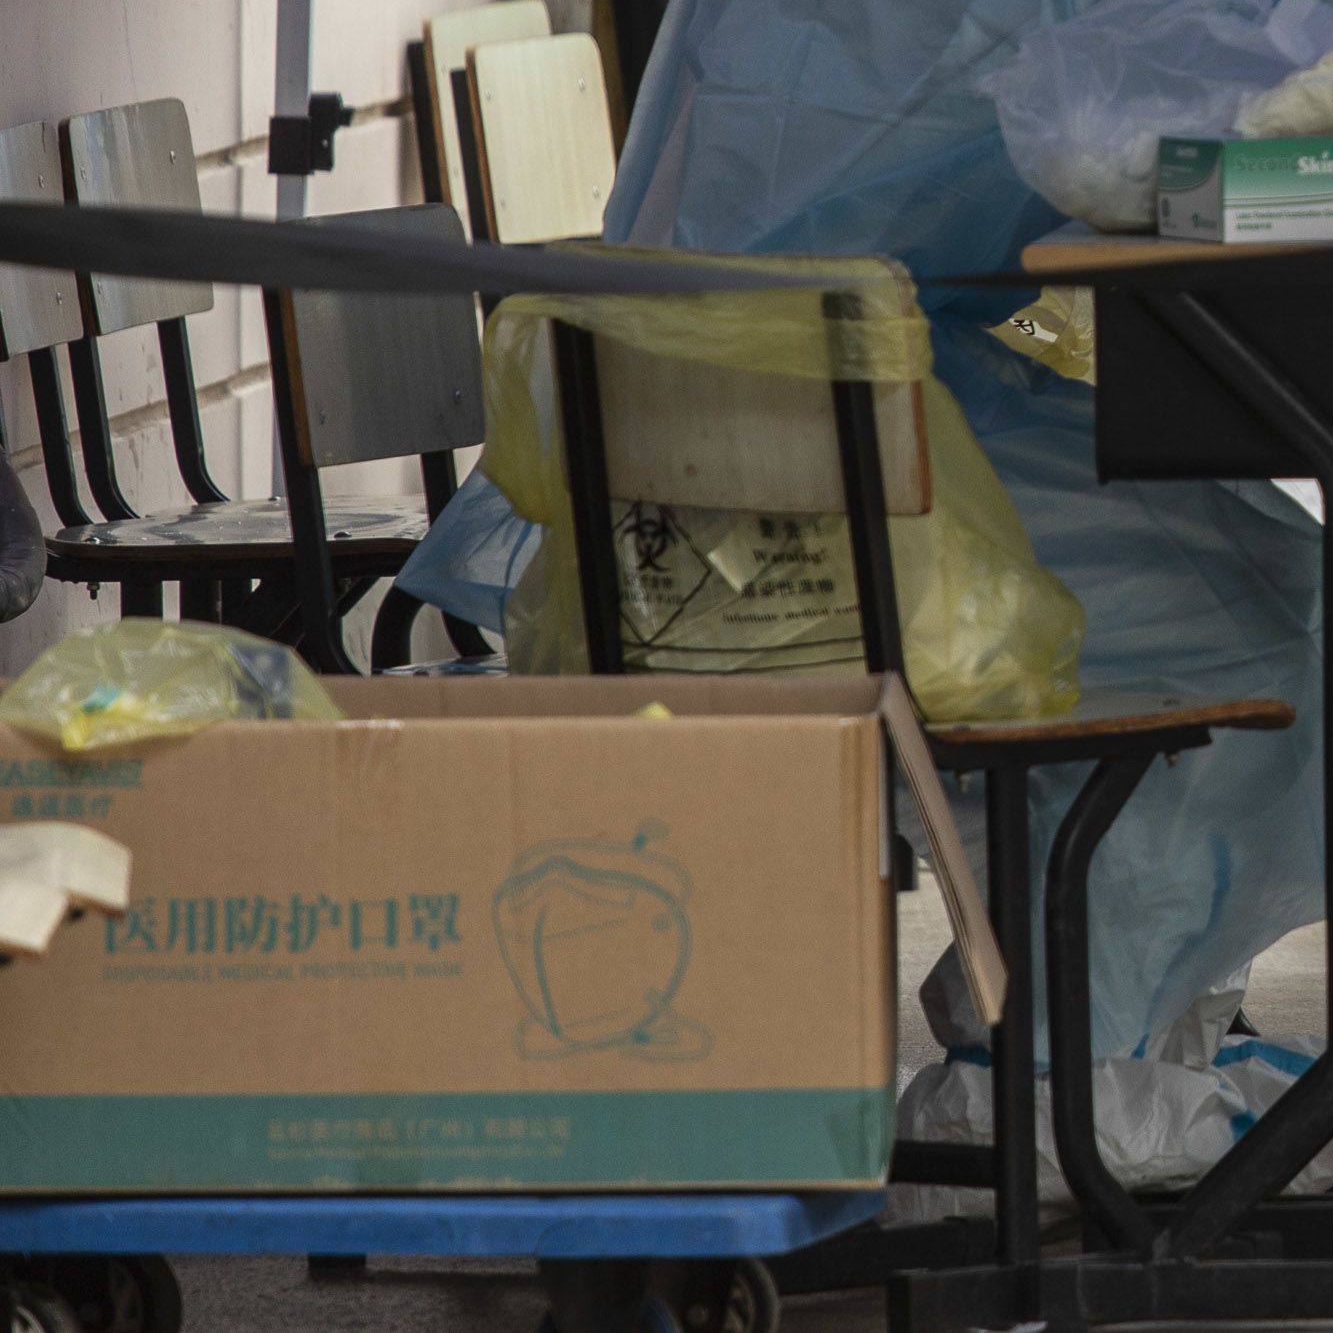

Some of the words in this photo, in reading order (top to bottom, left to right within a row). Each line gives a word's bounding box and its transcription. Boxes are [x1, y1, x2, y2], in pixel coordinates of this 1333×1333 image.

[104, 892, 462, 954] 医用防护口罩
[218, 962, 293, 982] MEDICAL
